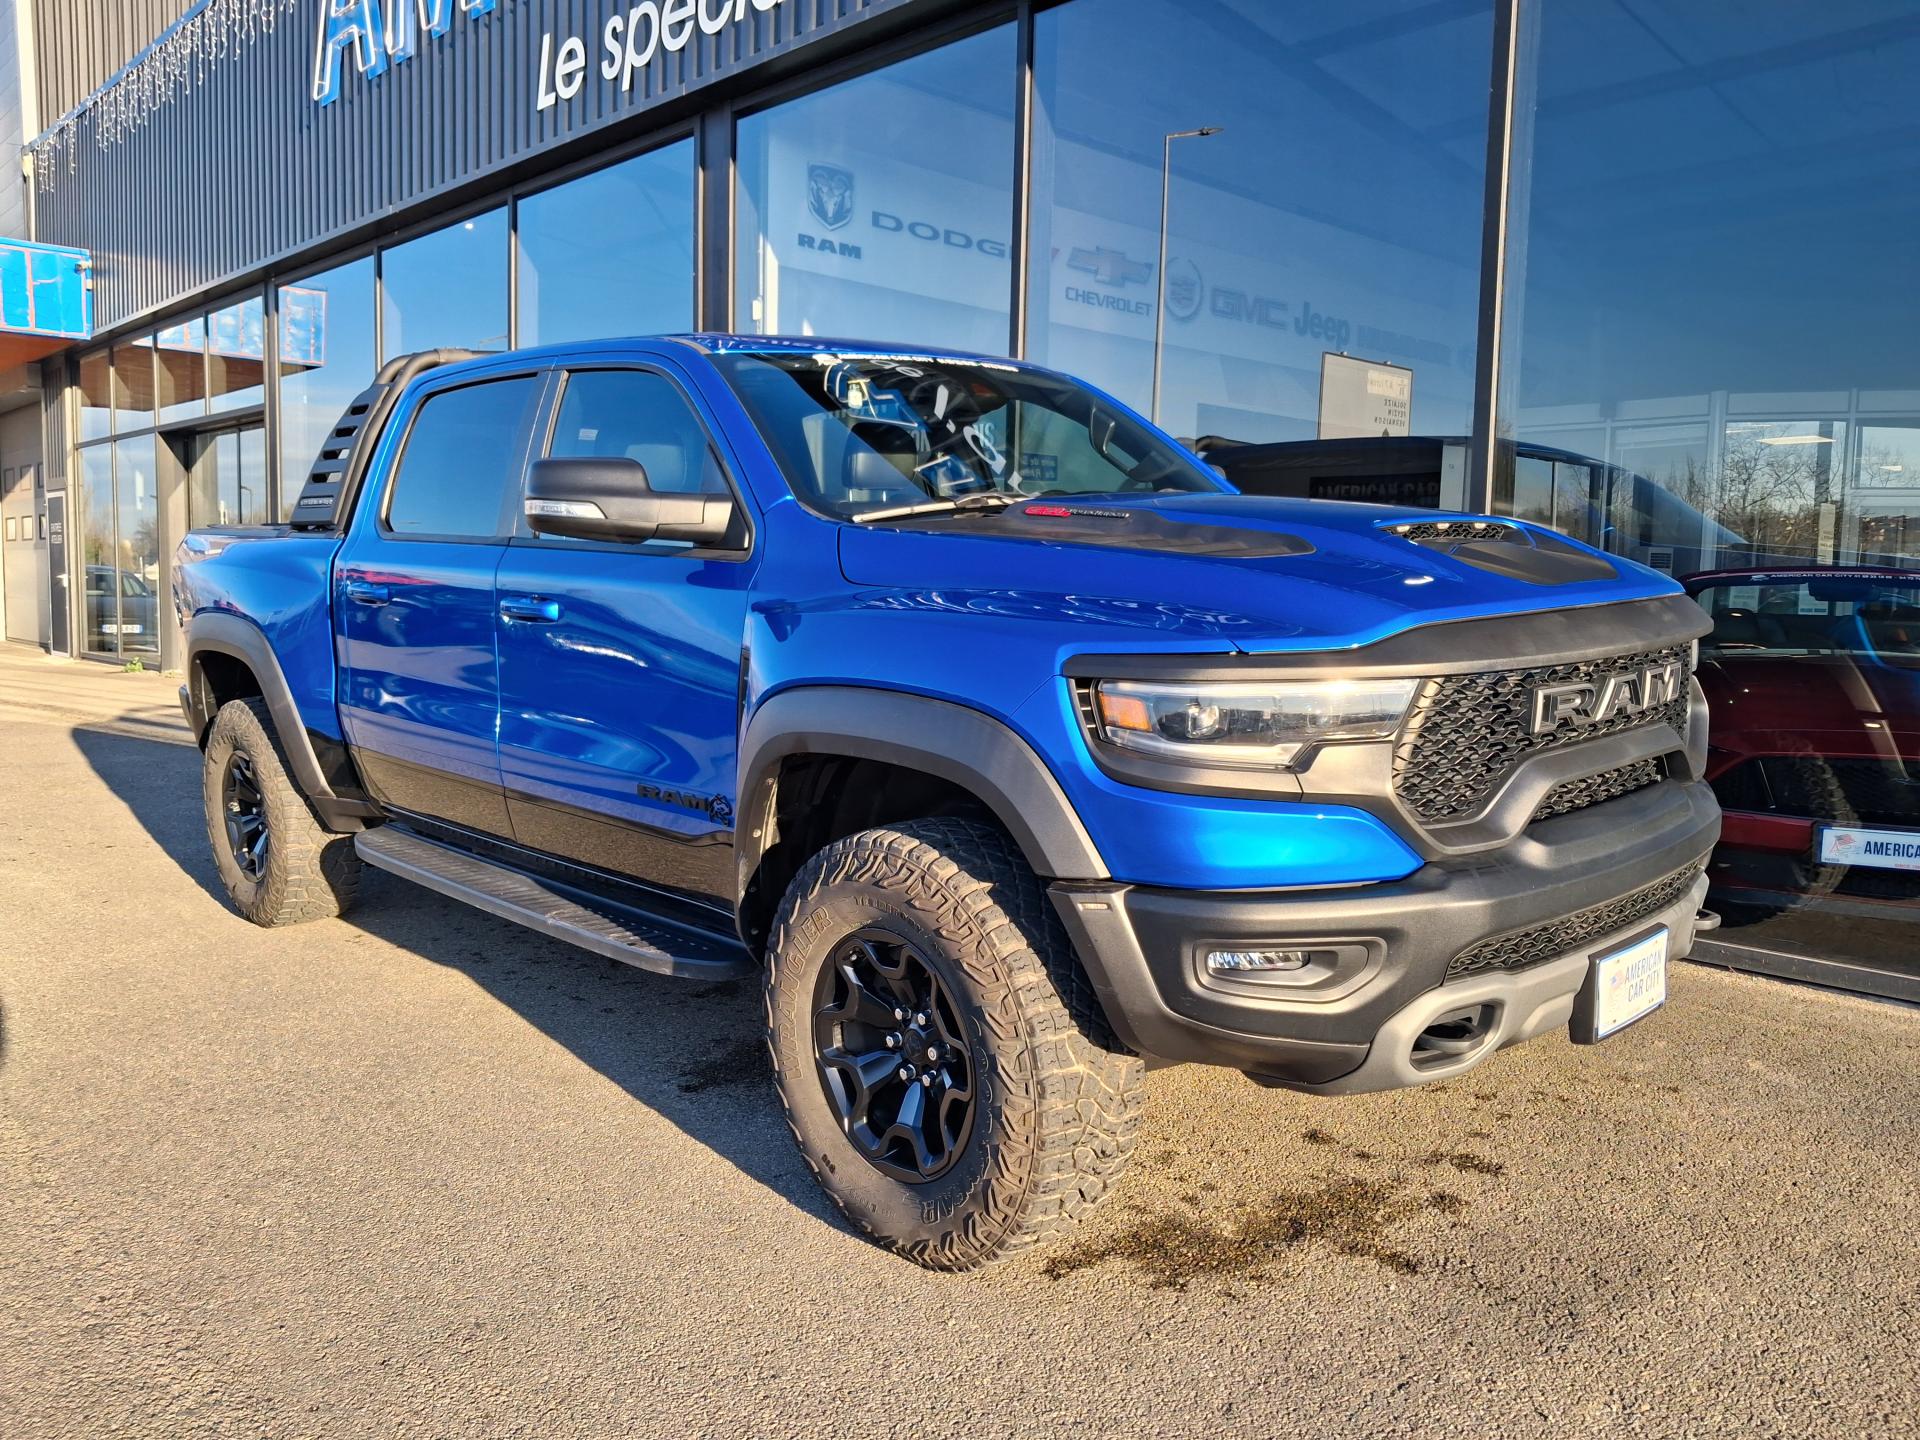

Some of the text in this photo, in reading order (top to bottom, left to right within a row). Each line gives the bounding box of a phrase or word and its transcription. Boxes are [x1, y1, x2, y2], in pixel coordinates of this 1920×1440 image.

[537, 33, 586, 111] Le
[798, 233, 862, 260] RAM
[871, 211, 1013, 260] DODG
[1065, 286, 1153, 317] CHEVROLET
[1210, 286, 1288, 330] GMC
[1294, 301, 1350, 351] Jeep
[1530, 661, 1683, 735] RAM
[637, 782, 711, 813] RAM
[1625, 950, 1663, 984] AMERICAN
[1628, 968, 1661, 1003] CAR CITY
[777, 906, 832, 1081] WRANGLER
